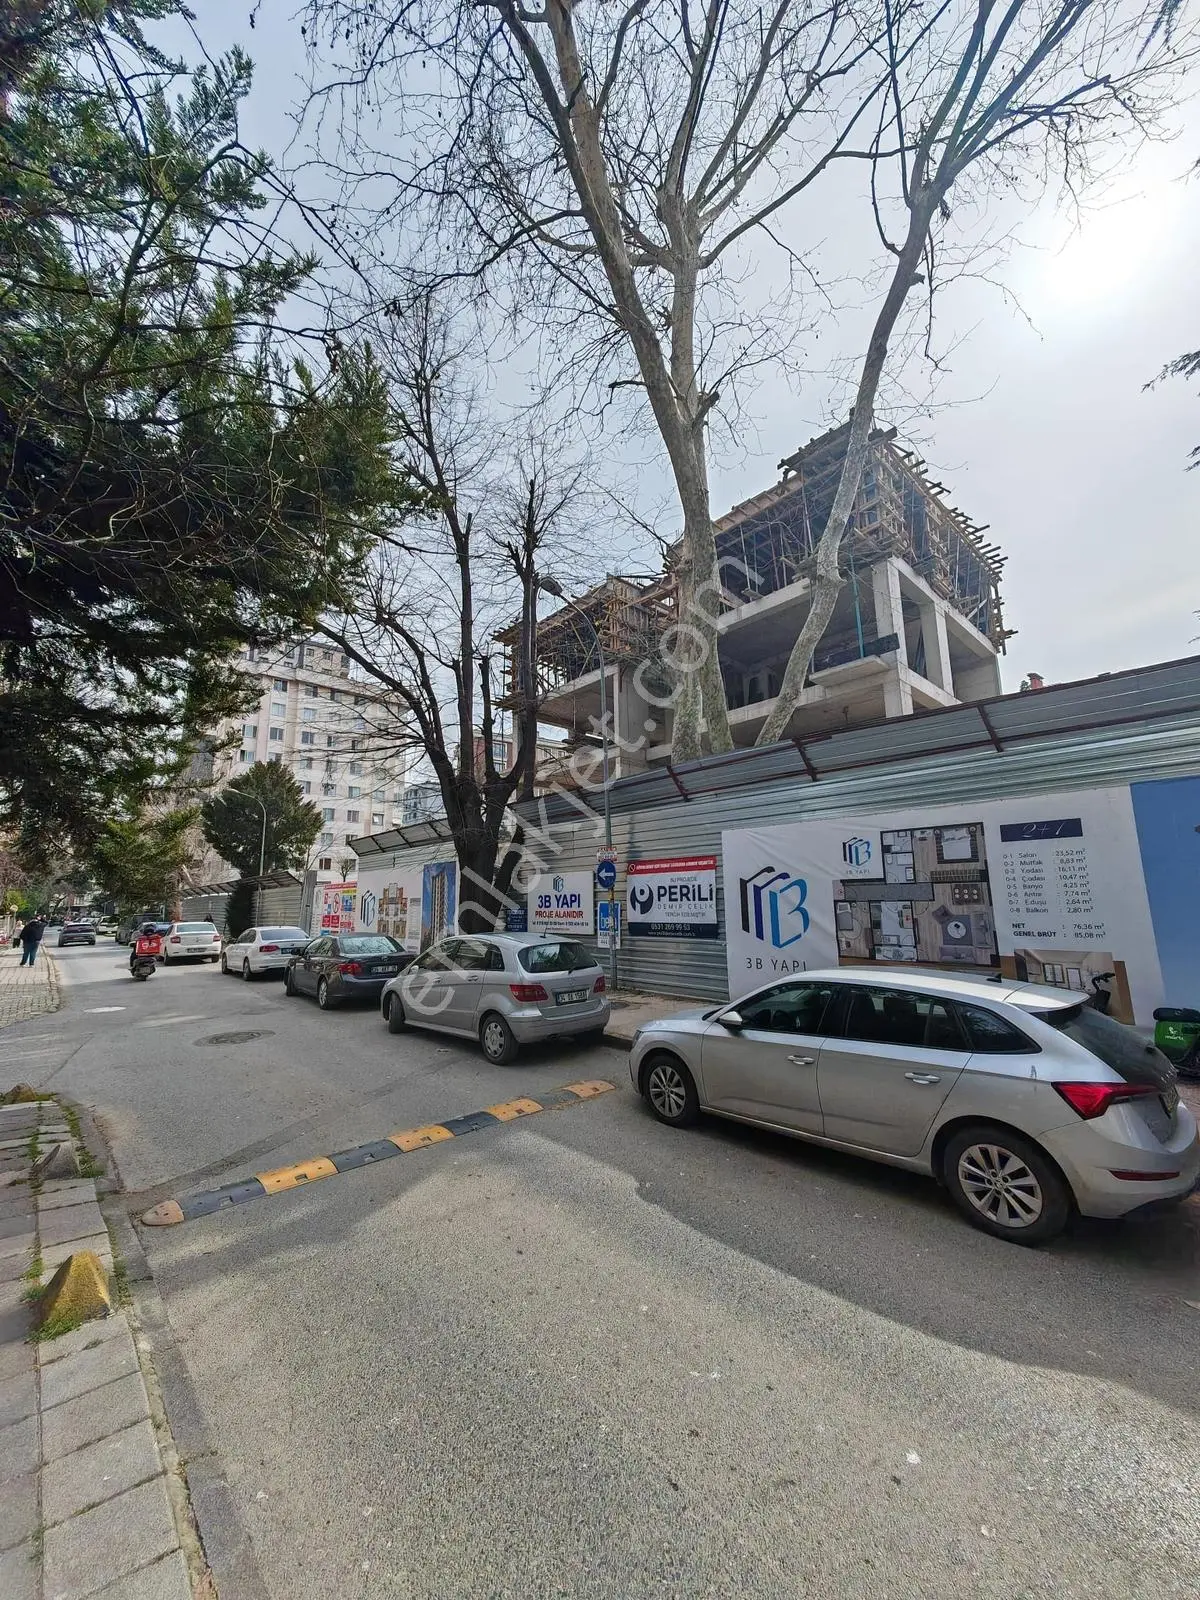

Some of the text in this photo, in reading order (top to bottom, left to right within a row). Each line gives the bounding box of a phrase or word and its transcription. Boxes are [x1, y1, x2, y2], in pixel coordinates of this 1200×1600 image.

[657, 884, 714, 902] PERİLİ
[538, 894, 581, 908] 3B YAPI
[535, 910, 584, 918] PROJE ALANIDIR
[746, 958, 807, 972] 3B YAPI
